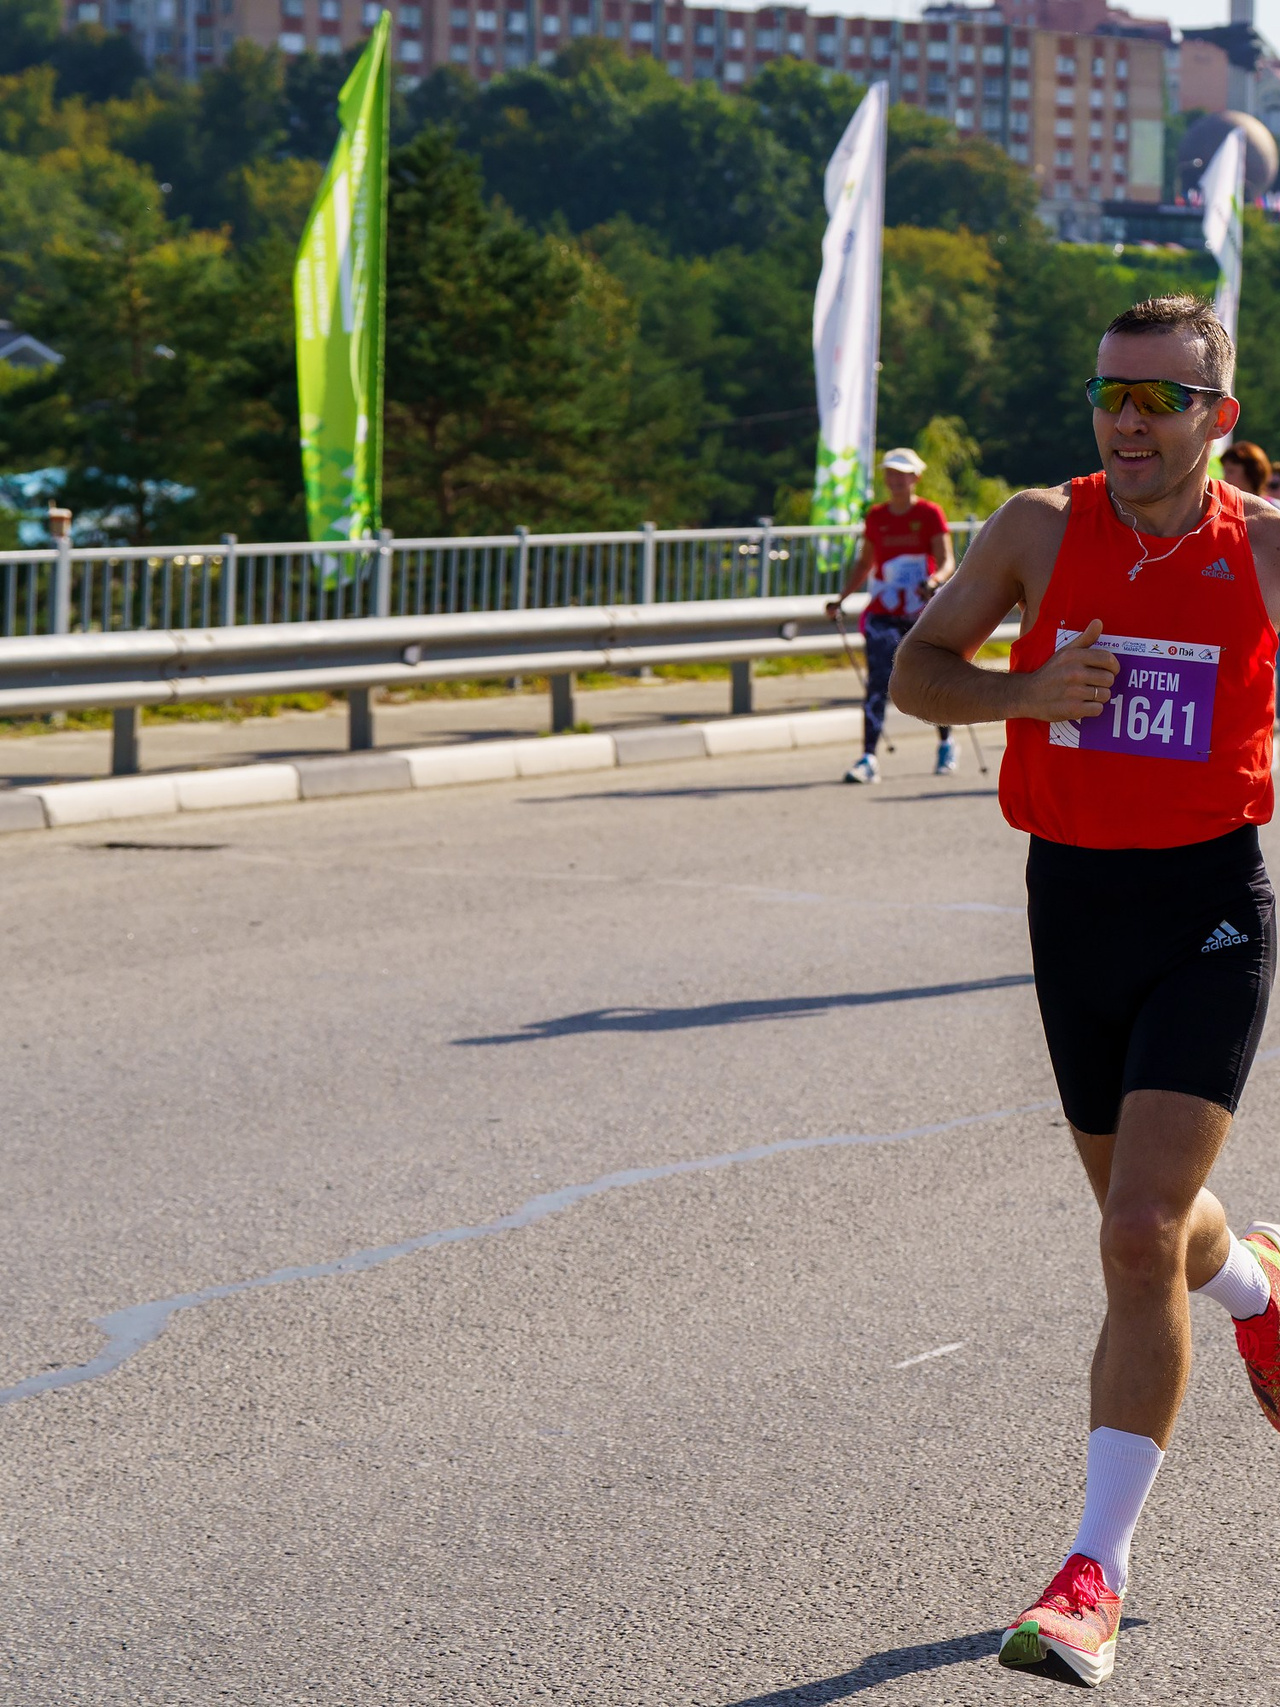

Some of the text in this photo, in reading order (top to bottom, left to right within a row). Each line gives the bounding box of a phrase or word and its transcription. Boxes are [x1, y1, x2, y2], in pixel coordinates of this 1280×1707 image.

[1201, 569, 1235, 581] adidas
[1178, 647, 1194, 657] Пэй
[1128, 668, 1180, 692] АРТЕМ
[1110, 694, 1196, 746] 1641
[1201, 934, 1249, 953] adidas
